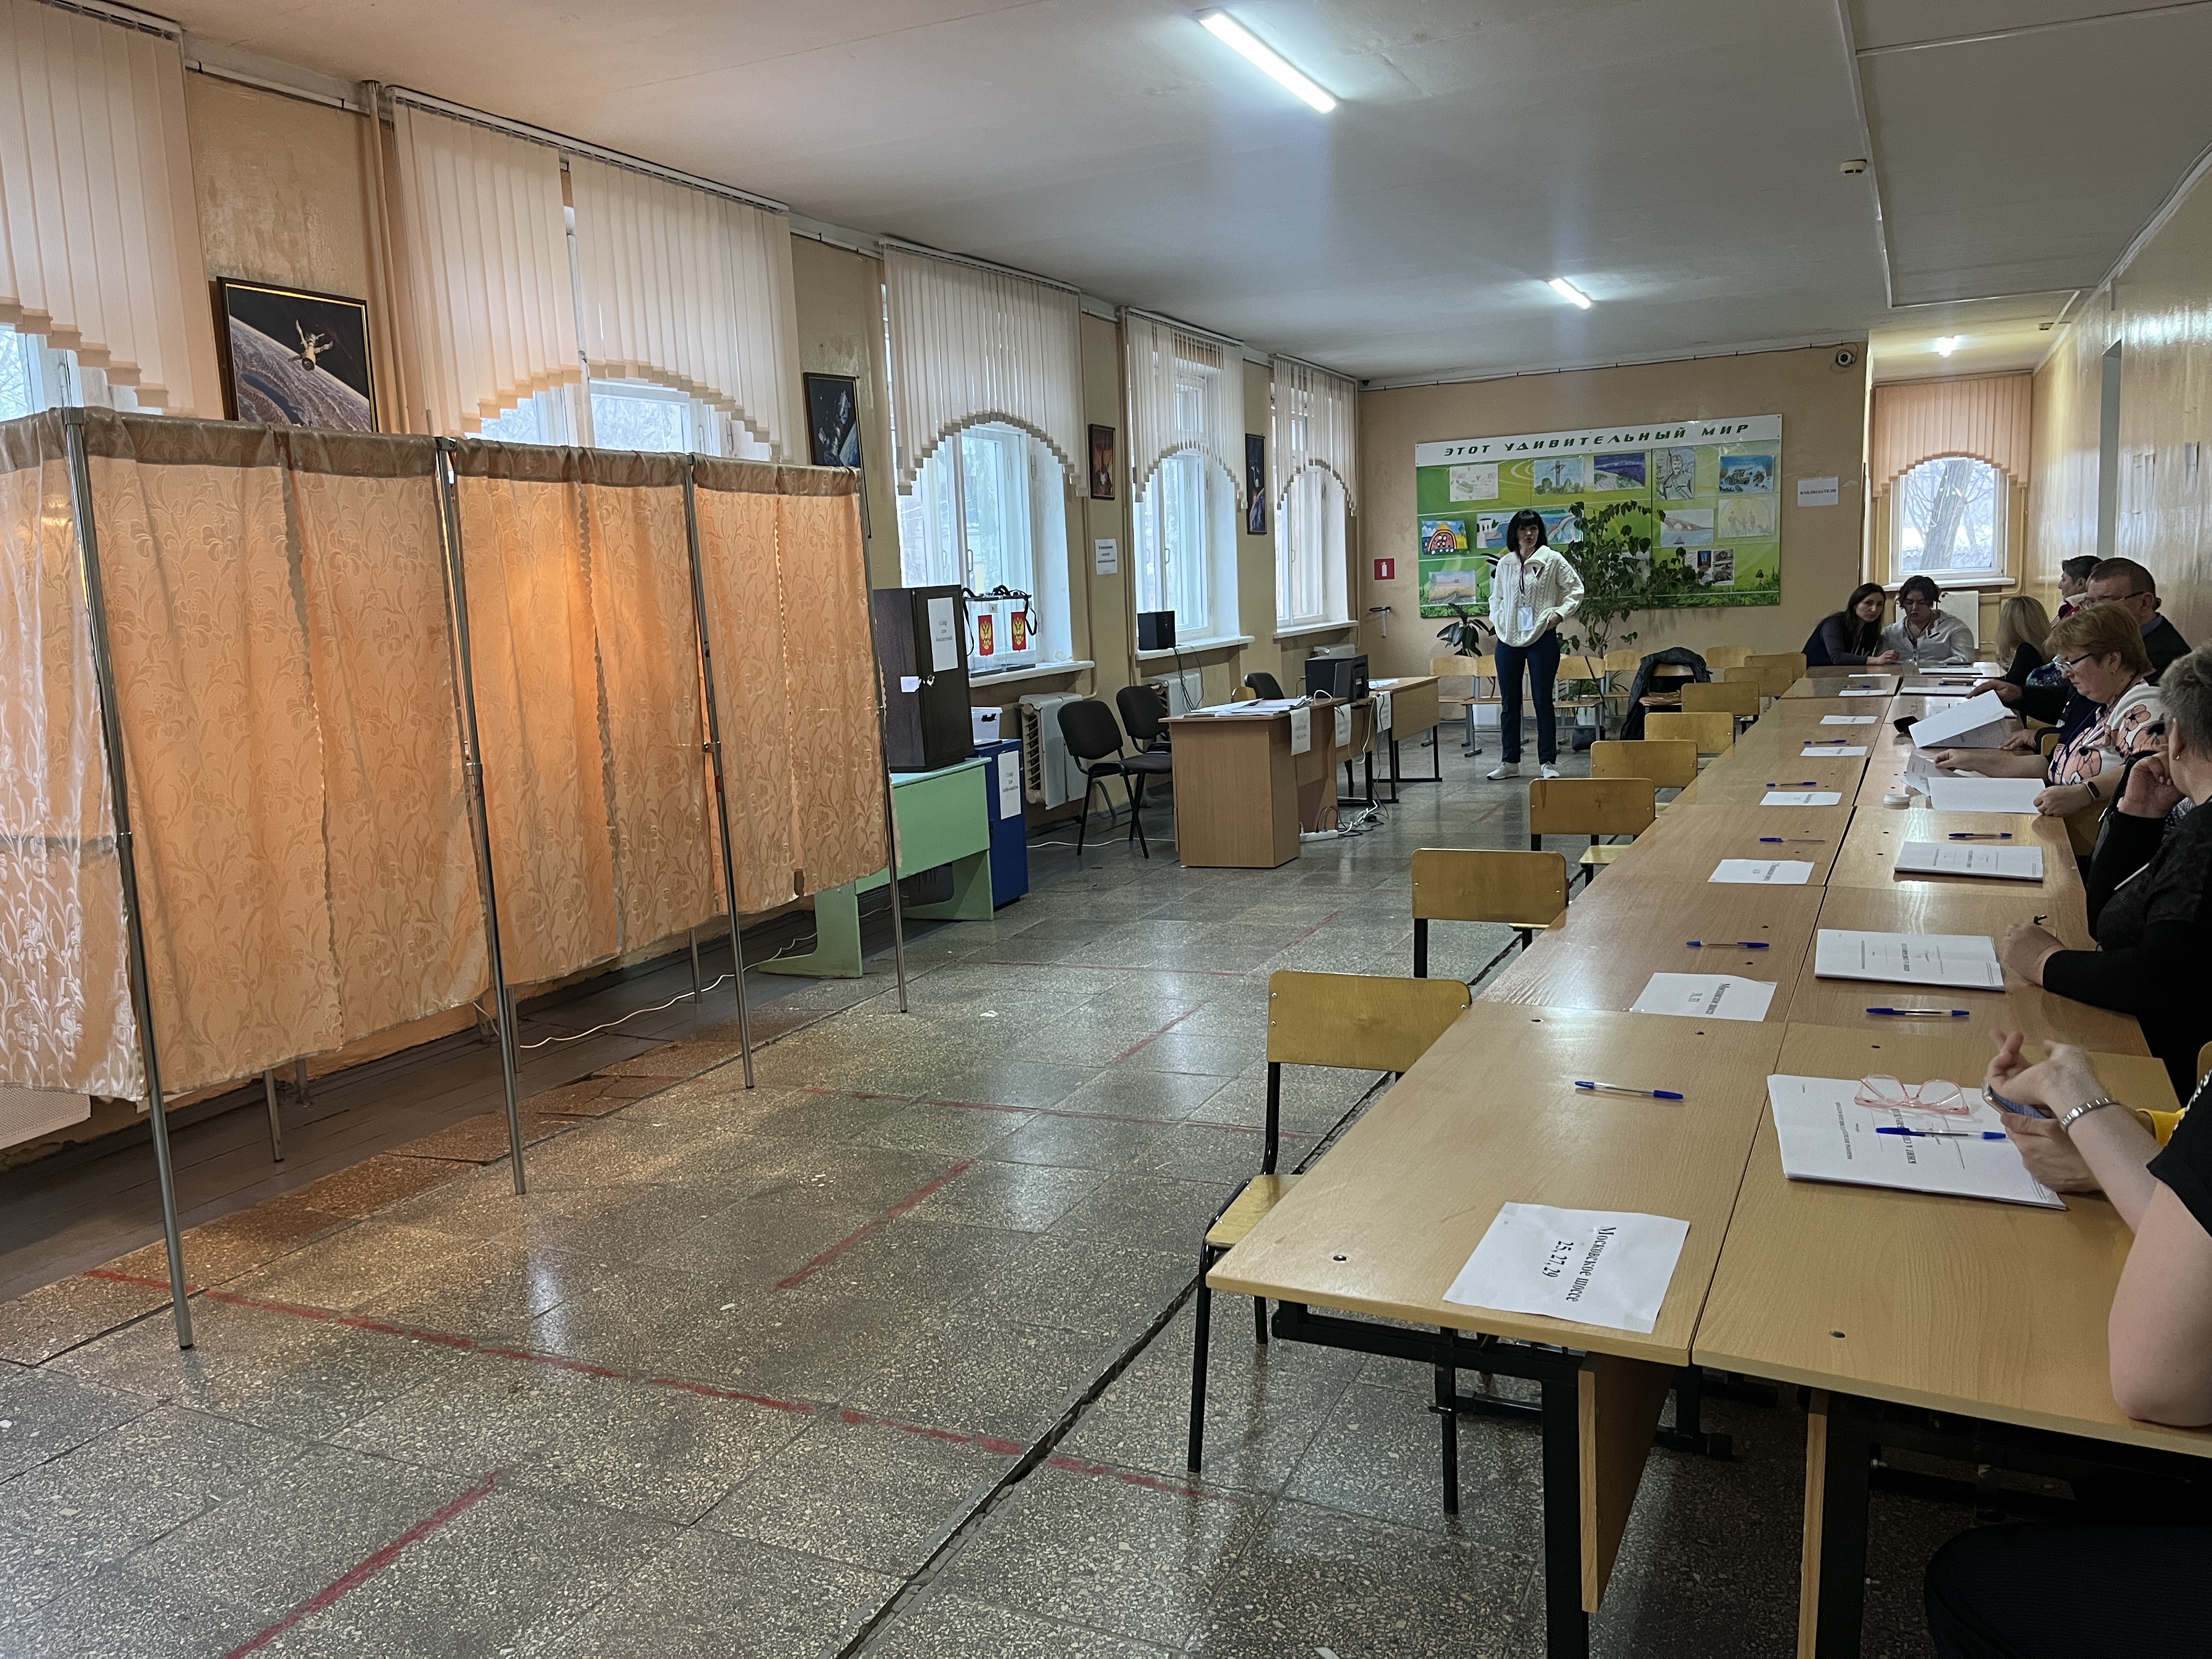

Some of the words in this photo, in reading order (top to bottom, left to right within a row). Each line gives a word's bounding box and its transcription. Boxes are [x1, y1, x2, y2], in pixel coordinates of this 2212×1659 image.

[1444, 445, 1490, 456] ЭТОТ
[1505, 427, 1686, 451] УДИВИТЕЛЬНЫЙ
[1701, 424, 1748, 437] МИР
[1550, 1240, 1574, 1252] 25,
[1579, 1226, 1617, 1276] Московское
[1543, 1254, 1567, 1265] 27,
[1542, 1267, 1561, 1278] 29
[1566, 1277, 1589, 1302] шоссе
